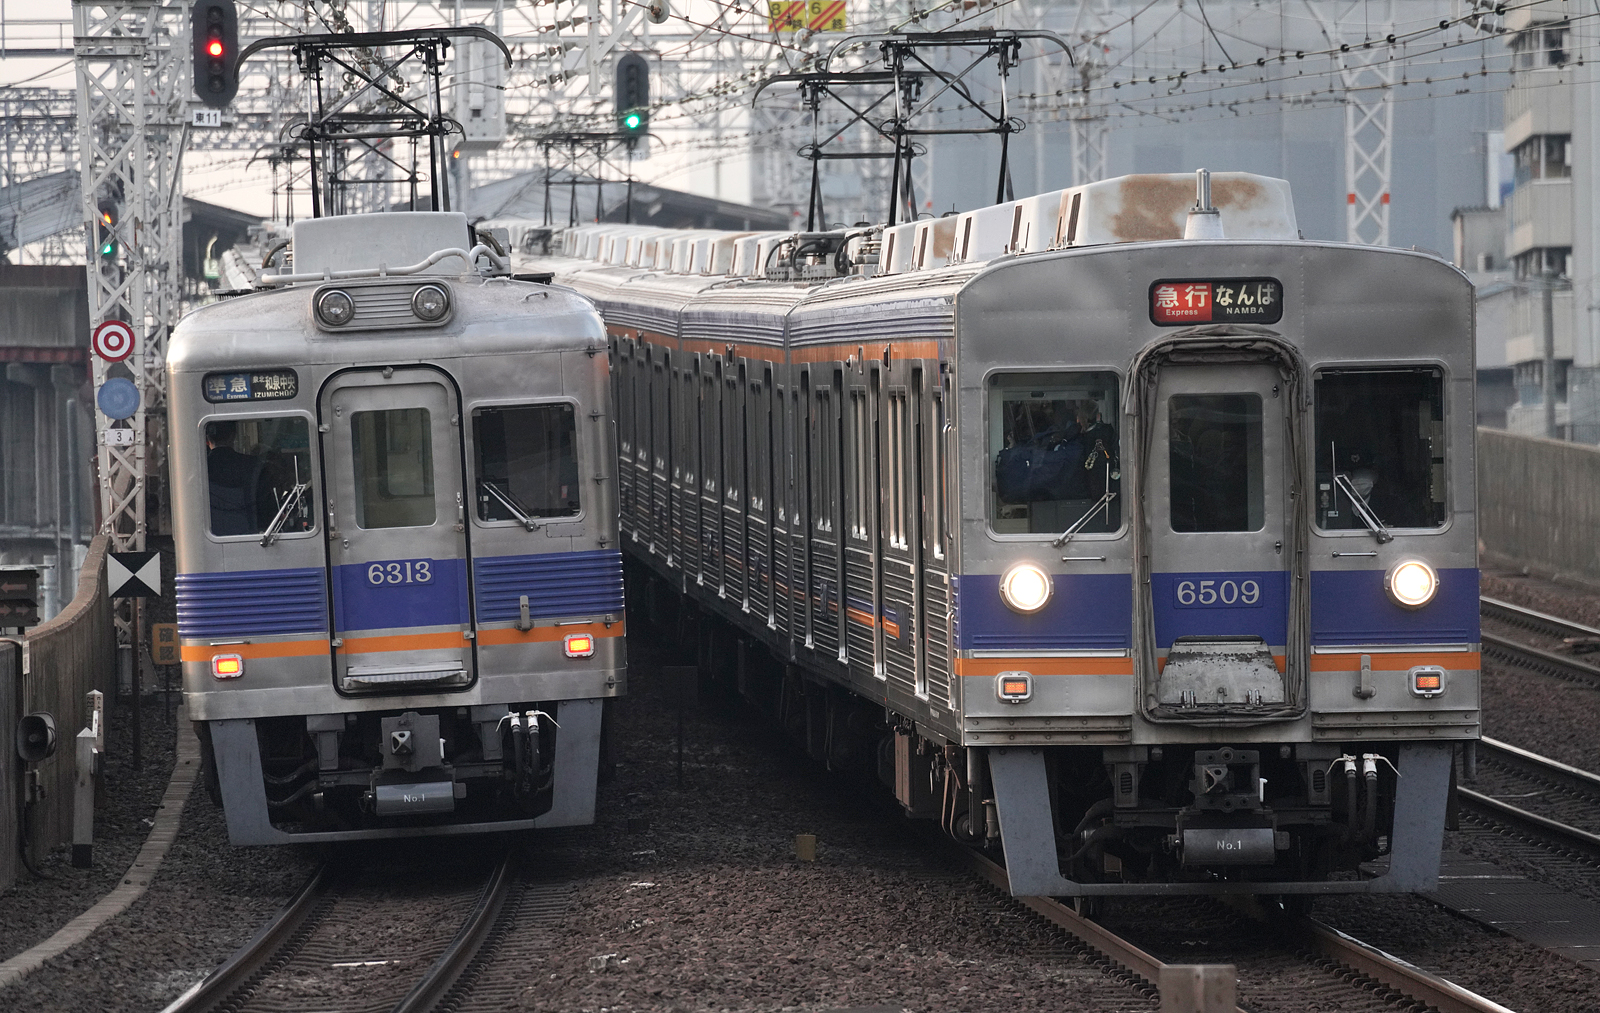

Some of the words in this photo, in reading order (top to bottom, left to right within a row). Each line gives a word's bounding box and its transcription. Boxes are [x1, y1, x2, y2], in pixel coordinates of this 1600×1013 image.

[771, 3, 781, 16] 8
[811, 2, 822, 15] 6
[195, 112, 217, 124] 東11
[1156, 286, 1209, 307] 急行
[1216, 284, 1275, 306] なんば
[1165, 308, 1198, 317] Express
[1226, 307, 1264, 315] NAMBA
[209, 377, 248, 394] 準急
[116, 431, 123, 442] 3
[368, 561, 431, 585] 6313
[1177, 580, 1260, 605] 6509
[403, 793, 425, 803] No.1
[1216, 839, 1241, 850] No.1
